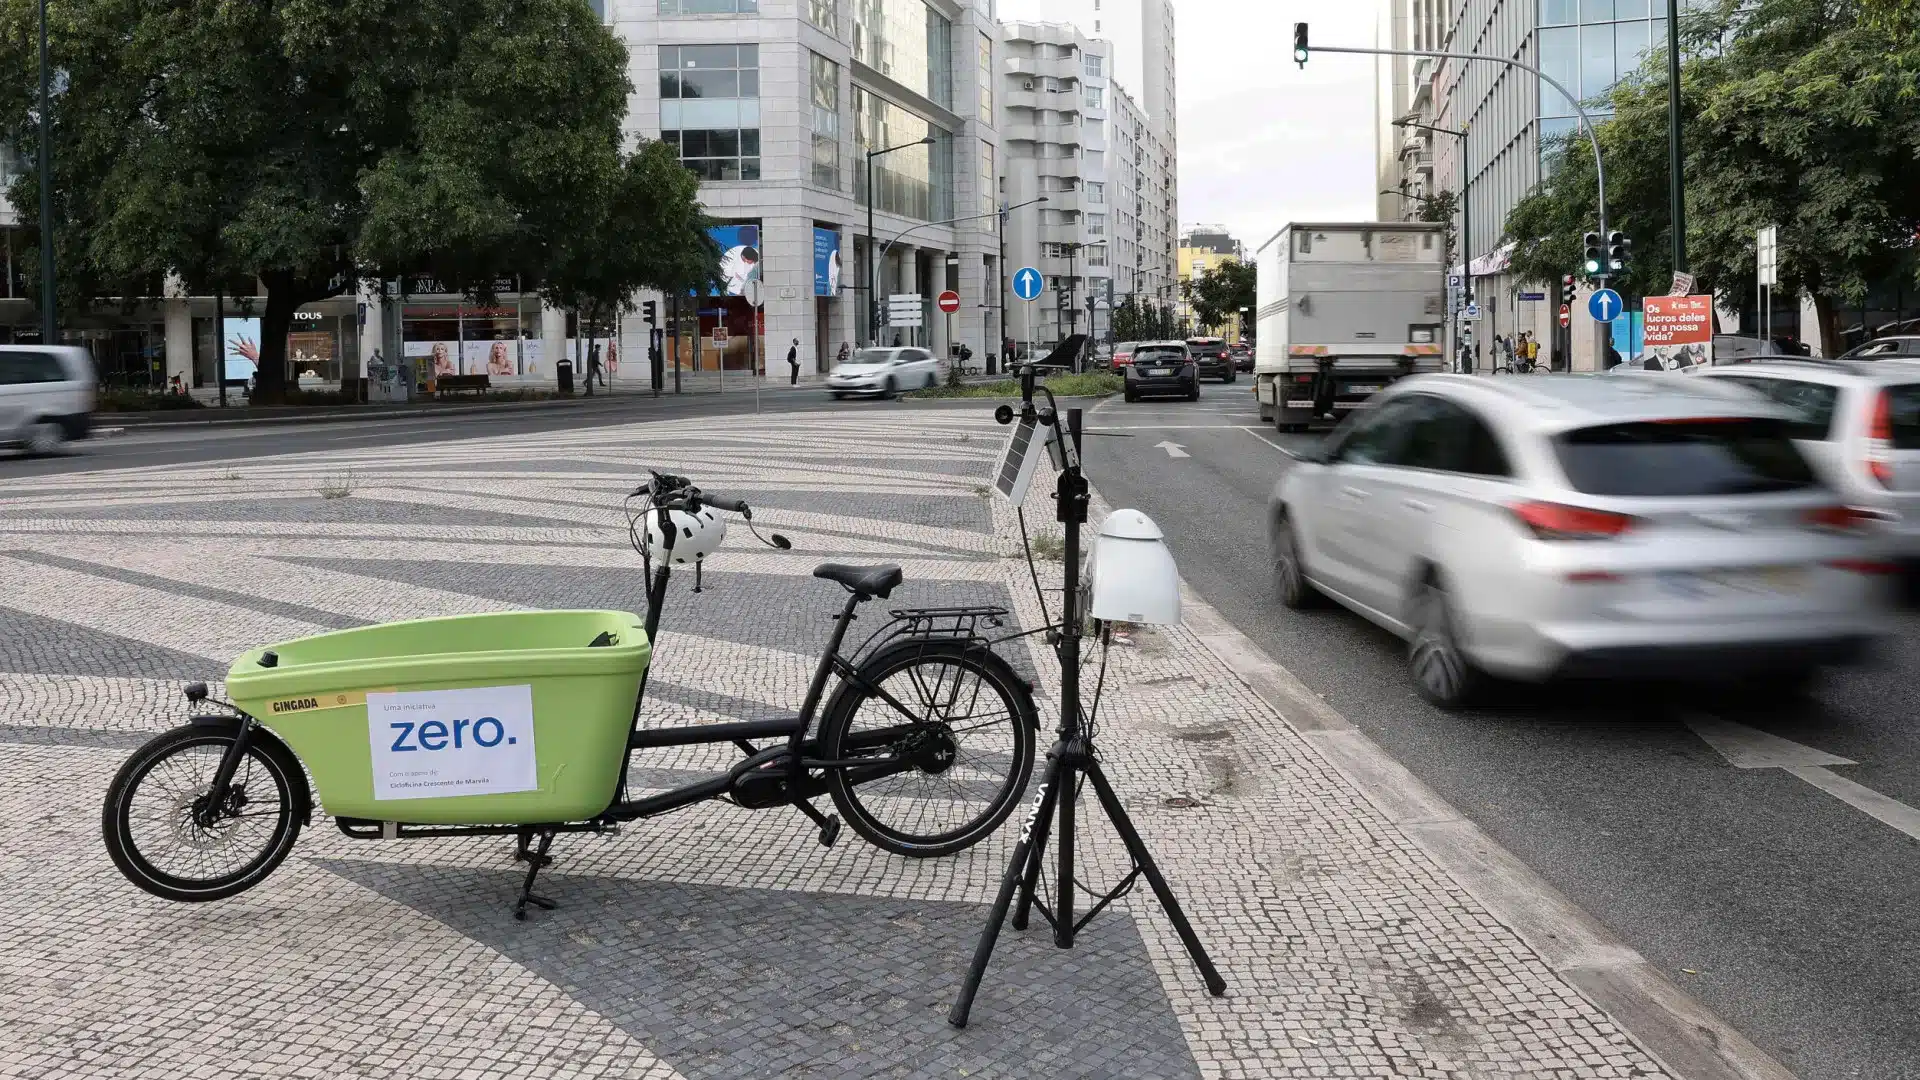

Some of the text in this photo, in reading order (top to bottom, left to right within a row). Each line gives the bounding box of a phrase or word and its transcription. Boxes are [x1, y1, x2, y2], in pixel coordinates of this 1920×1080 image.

[1451, 277, 1458, 286] P
[1646, 304, 1660, 313] Os
[293, 312, 322, 320] TOUS
[1646, 313, 1706, 323] lucros deles
[1647, 331, 1674, 341] vida?
[273, 697, 319, 712] GINGADA
[384, 702, 436, 711] Uma iniciativa
[390, 716, 517, 752] zero.
[424, 779, 454, 787] Crescente
[465, 777, 490, 785] Marvila
[1019, 783, 1049, 844] VONYX
